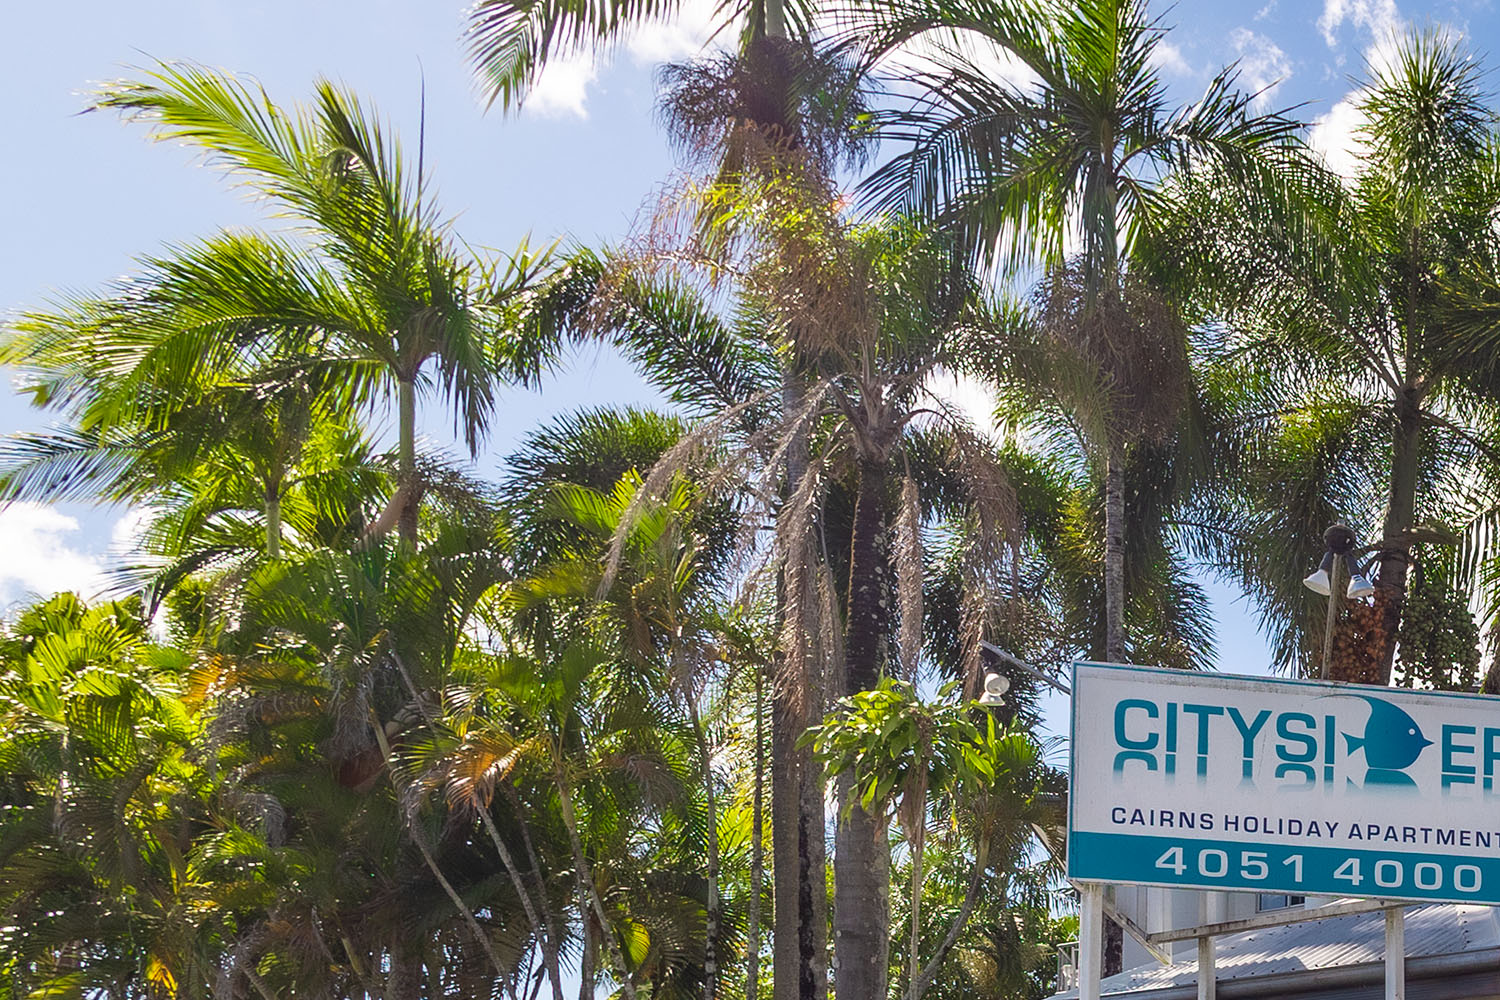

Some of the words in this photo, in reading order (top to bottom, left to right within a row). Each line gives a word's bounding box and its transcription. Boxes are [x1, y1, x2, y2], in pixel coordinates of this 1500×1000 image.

[1111, 807, 1214, 830] CAIRNS
[1224, 814, 1339, 838] HOLIDAY
[1155, 846, 1303, 883] 4051
[1333, 857, 1482, 893] 4000
